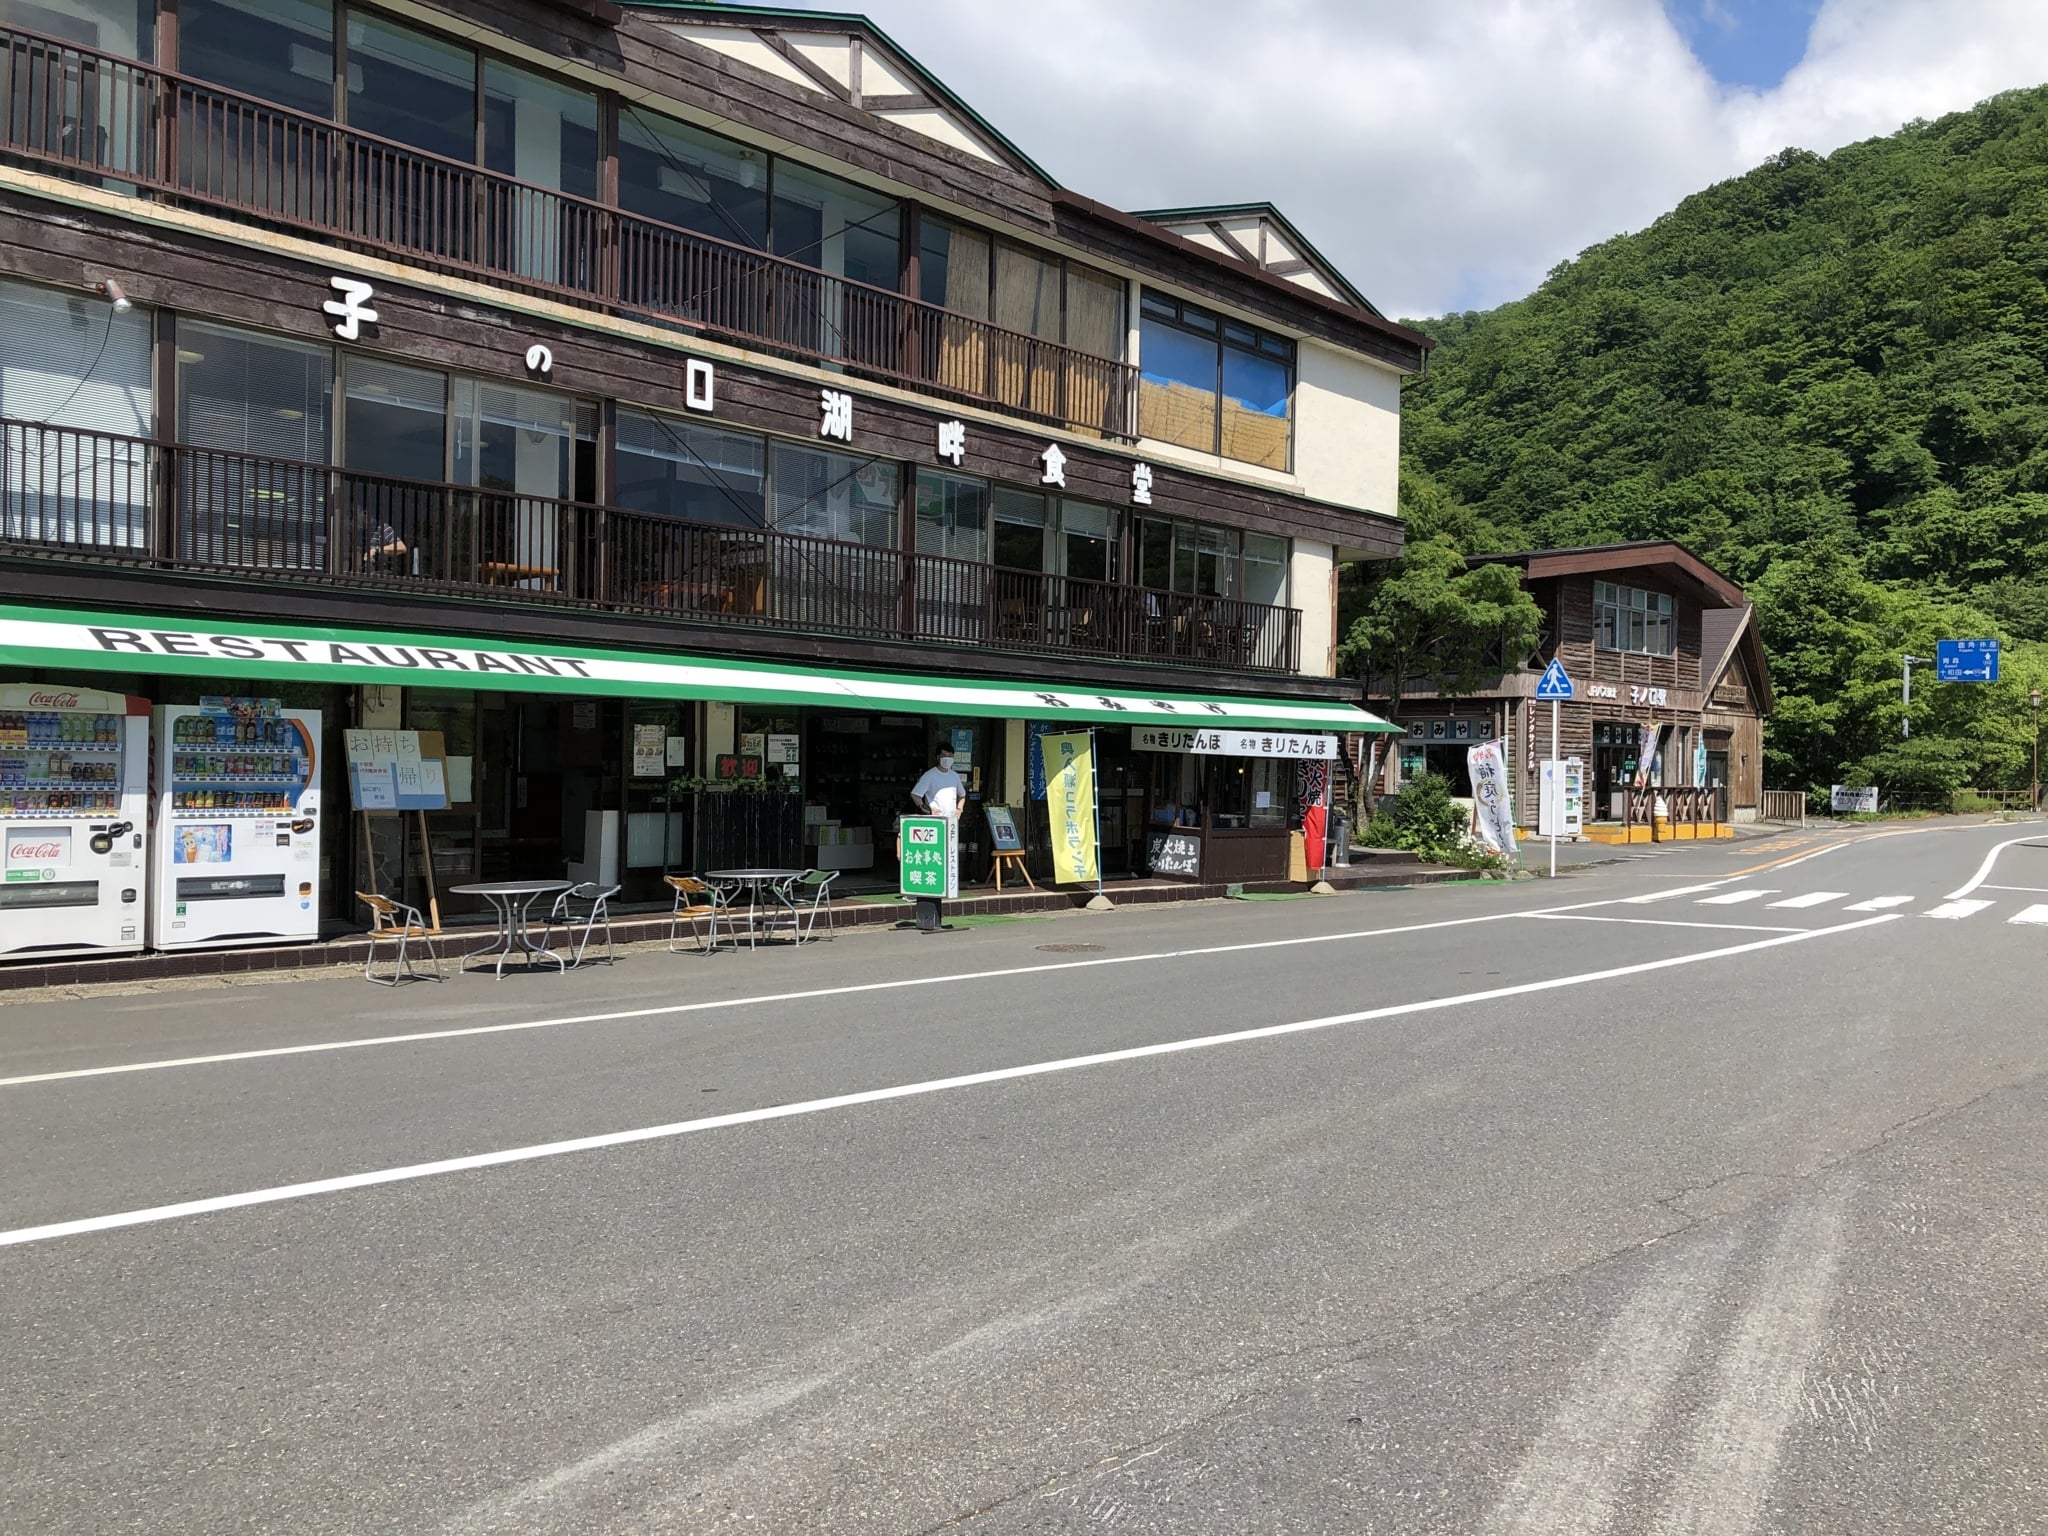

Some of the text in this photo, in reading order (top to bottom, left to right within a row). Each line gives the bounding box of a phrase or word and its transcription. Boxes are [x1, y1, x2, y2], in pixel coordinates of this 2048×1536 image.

[323, 276, 1152, 505] 子の口湖畔食堂
[87, 627, 592, 678] RESTAURANT
[29, 691, 80, 708] Coca-Cola
[1413, 723, 1492, 736] おみやげ
[1528, 707, 1537, 769] レンタサイクル
[351, 735, 416, 754] お持ち
[1142, 733, 1155, 745] 名物
[1240, 739, 1256, 750] 名物
[400, 766, 436, 785] 帰り
[721, 756, 758, 779] 歓迎
[924, 829, 934, 842] 2F
[10, 842, 62, 859] Coca-Cola
[1150, 838, 1196, 855] 炭火焼き
[905, 849, 942, 866] お食事処
[909, 870, 937, 886] 喫茶
